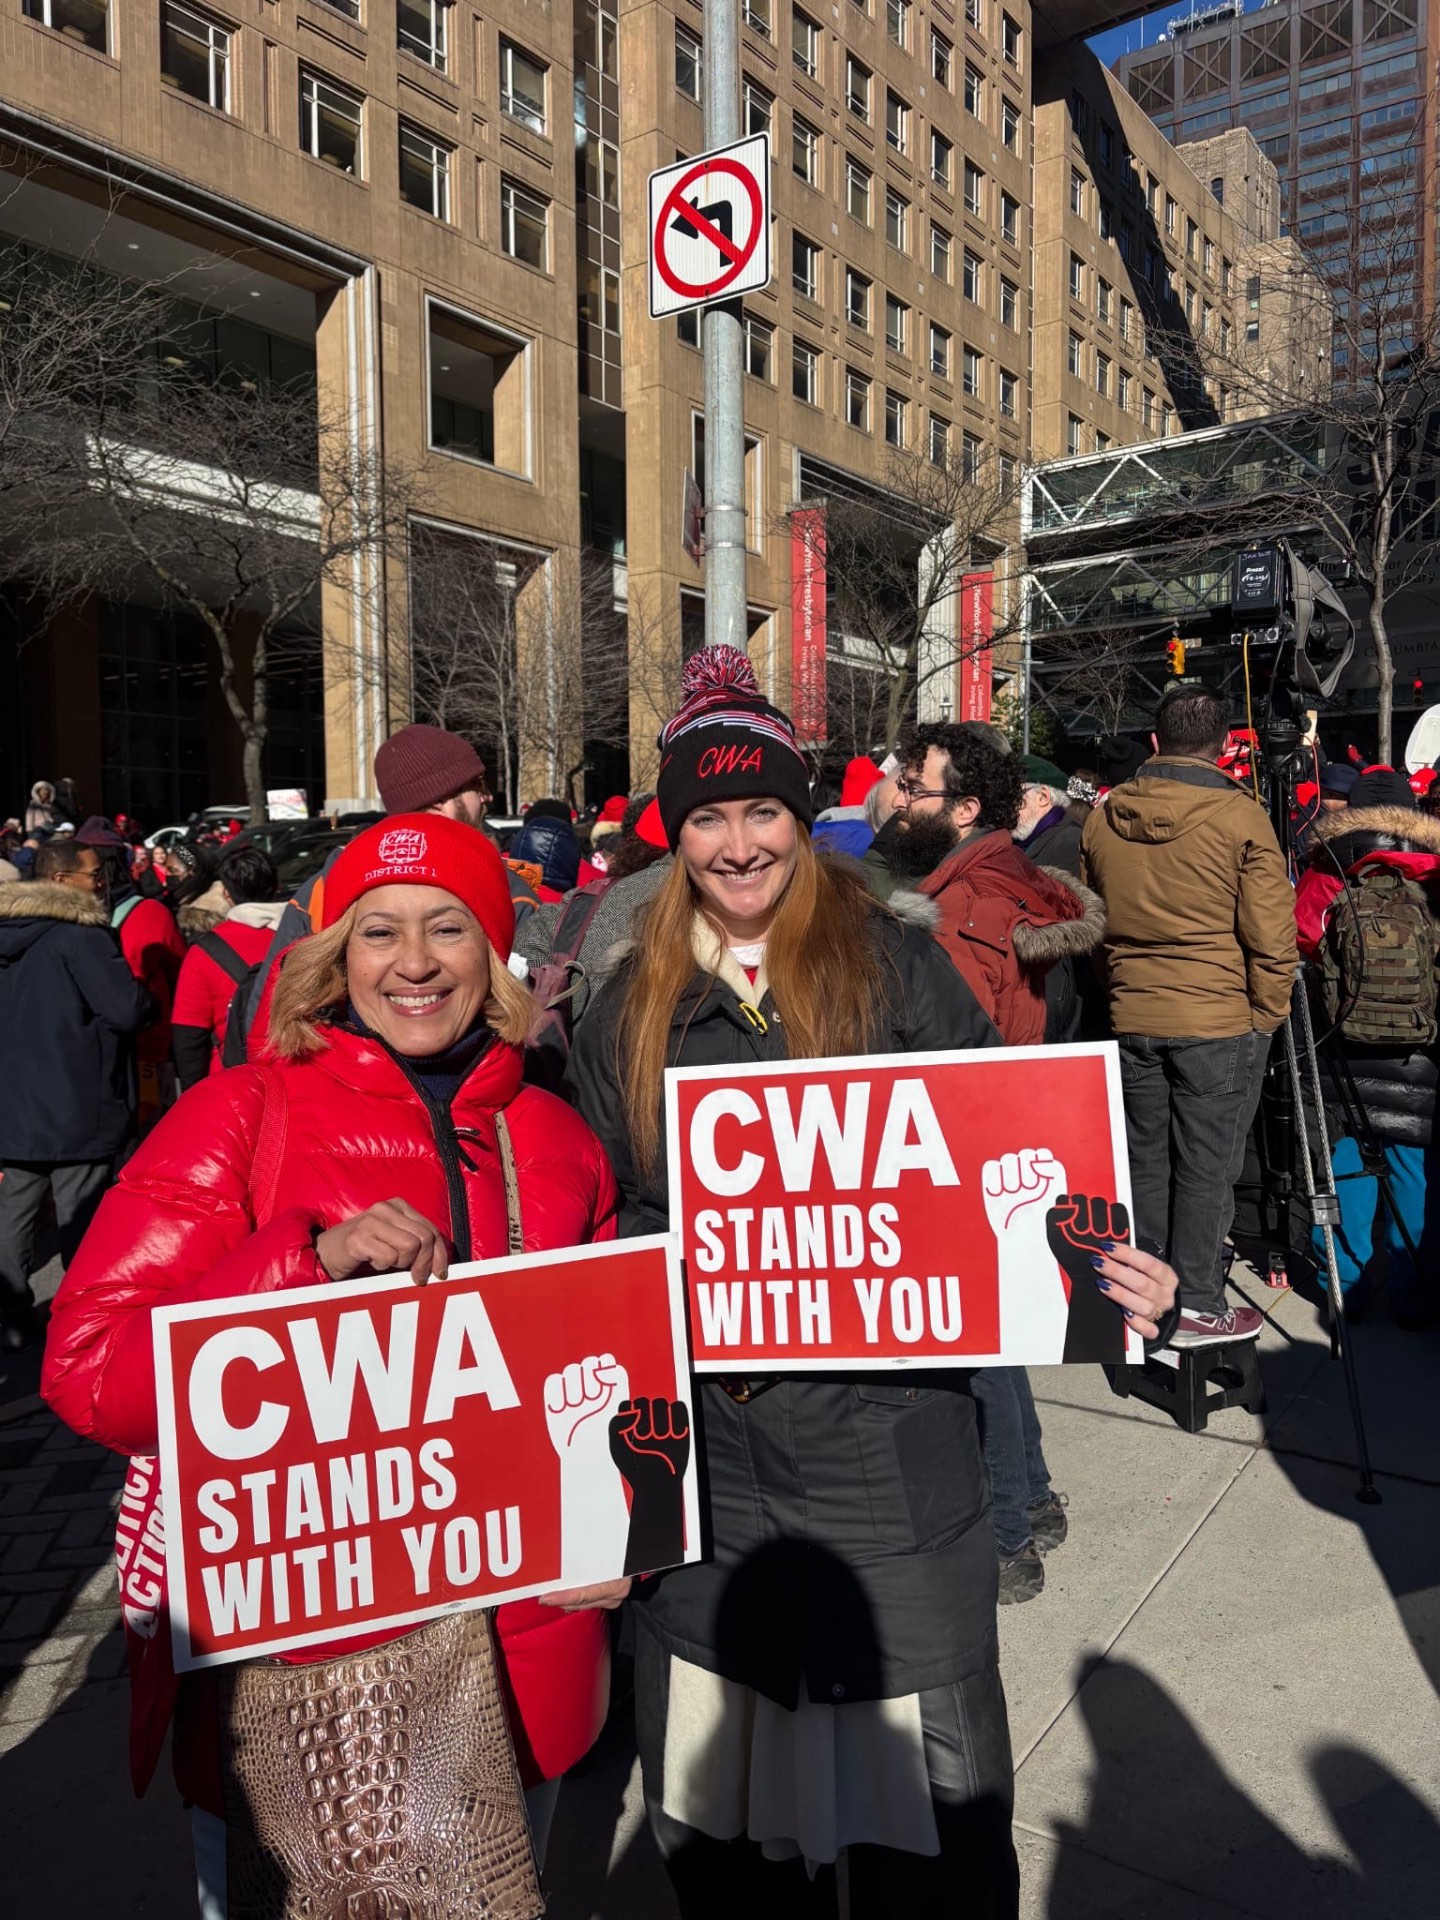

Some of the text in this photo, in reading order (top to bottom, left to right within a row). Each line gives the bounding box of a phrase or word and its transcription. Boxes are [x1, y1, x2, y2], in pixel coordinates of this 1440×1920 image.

[1364, 642, 1438, 658] CUMBIA
[698, 744, 765, 778] CWA
[364, 865, 438, 882] DISTRICT 1
[385, 833, 420, 845] CWA
[690, 1079, 960, 1196] CWA
[695, 1203, 901, 1272] STANDS
[697, 1277, 963, 1346] WITH YOU
[188, 1292, 521, 1460] CWA
[197, 1439, 457, 1553] STANDS
[201, 1506, 523, 1637] WITH YOU
